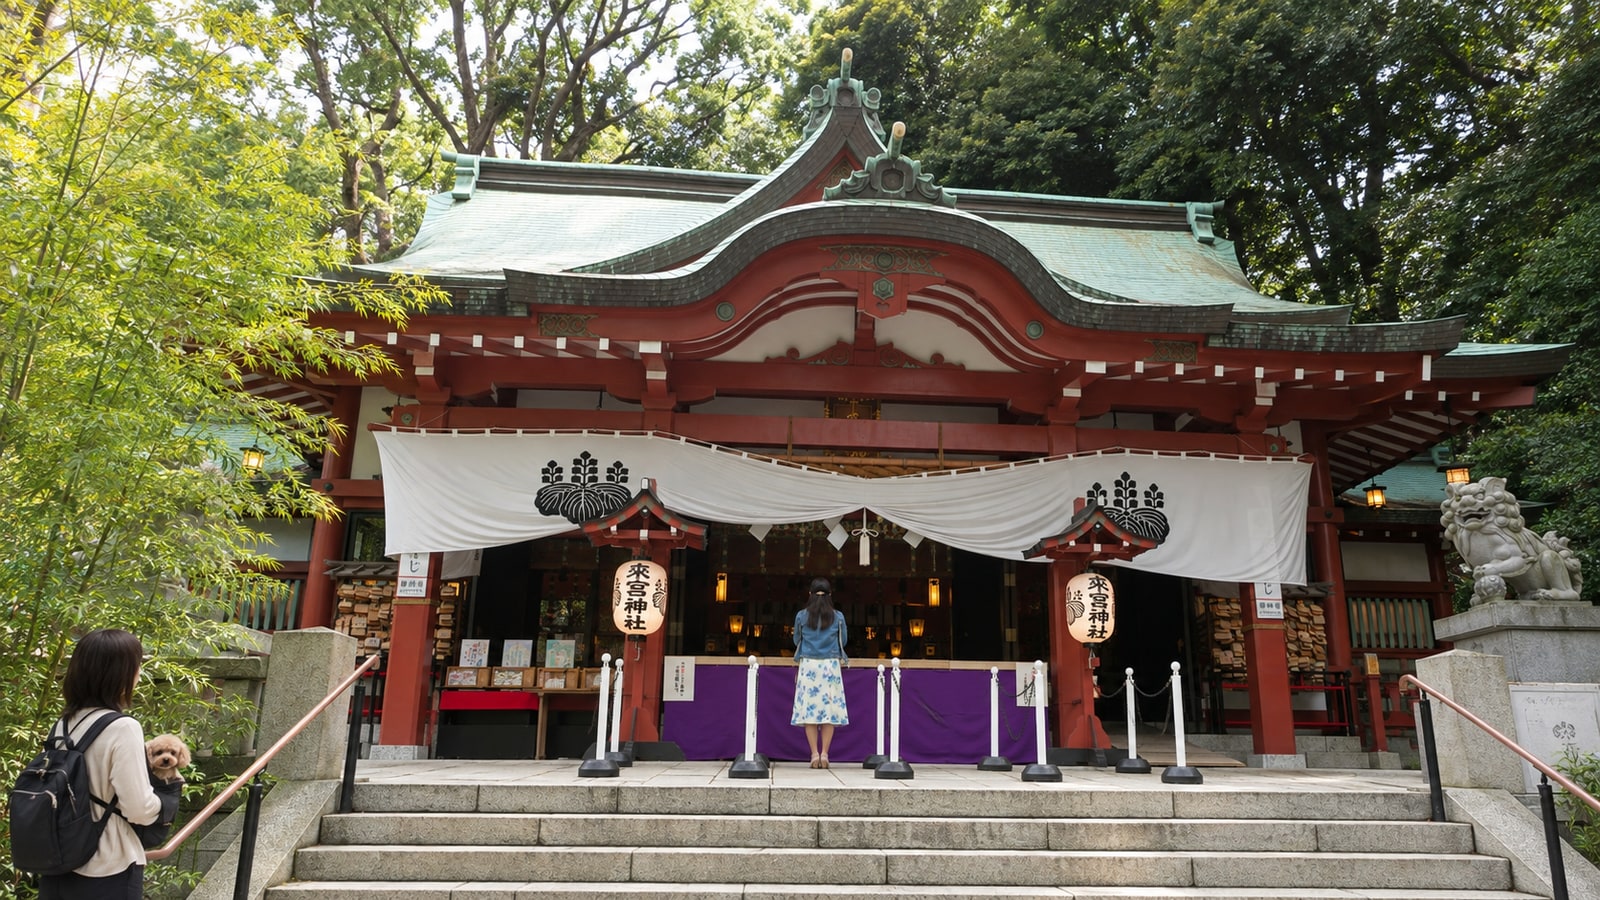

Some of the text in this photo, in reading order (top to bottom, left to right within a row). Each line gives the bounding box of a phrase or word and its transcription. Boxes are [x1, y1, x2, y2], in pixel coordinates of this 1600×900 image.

[624, 563, 650, 630] 來宮神社
[1087, 576, 1109, 638] 來宮神社
